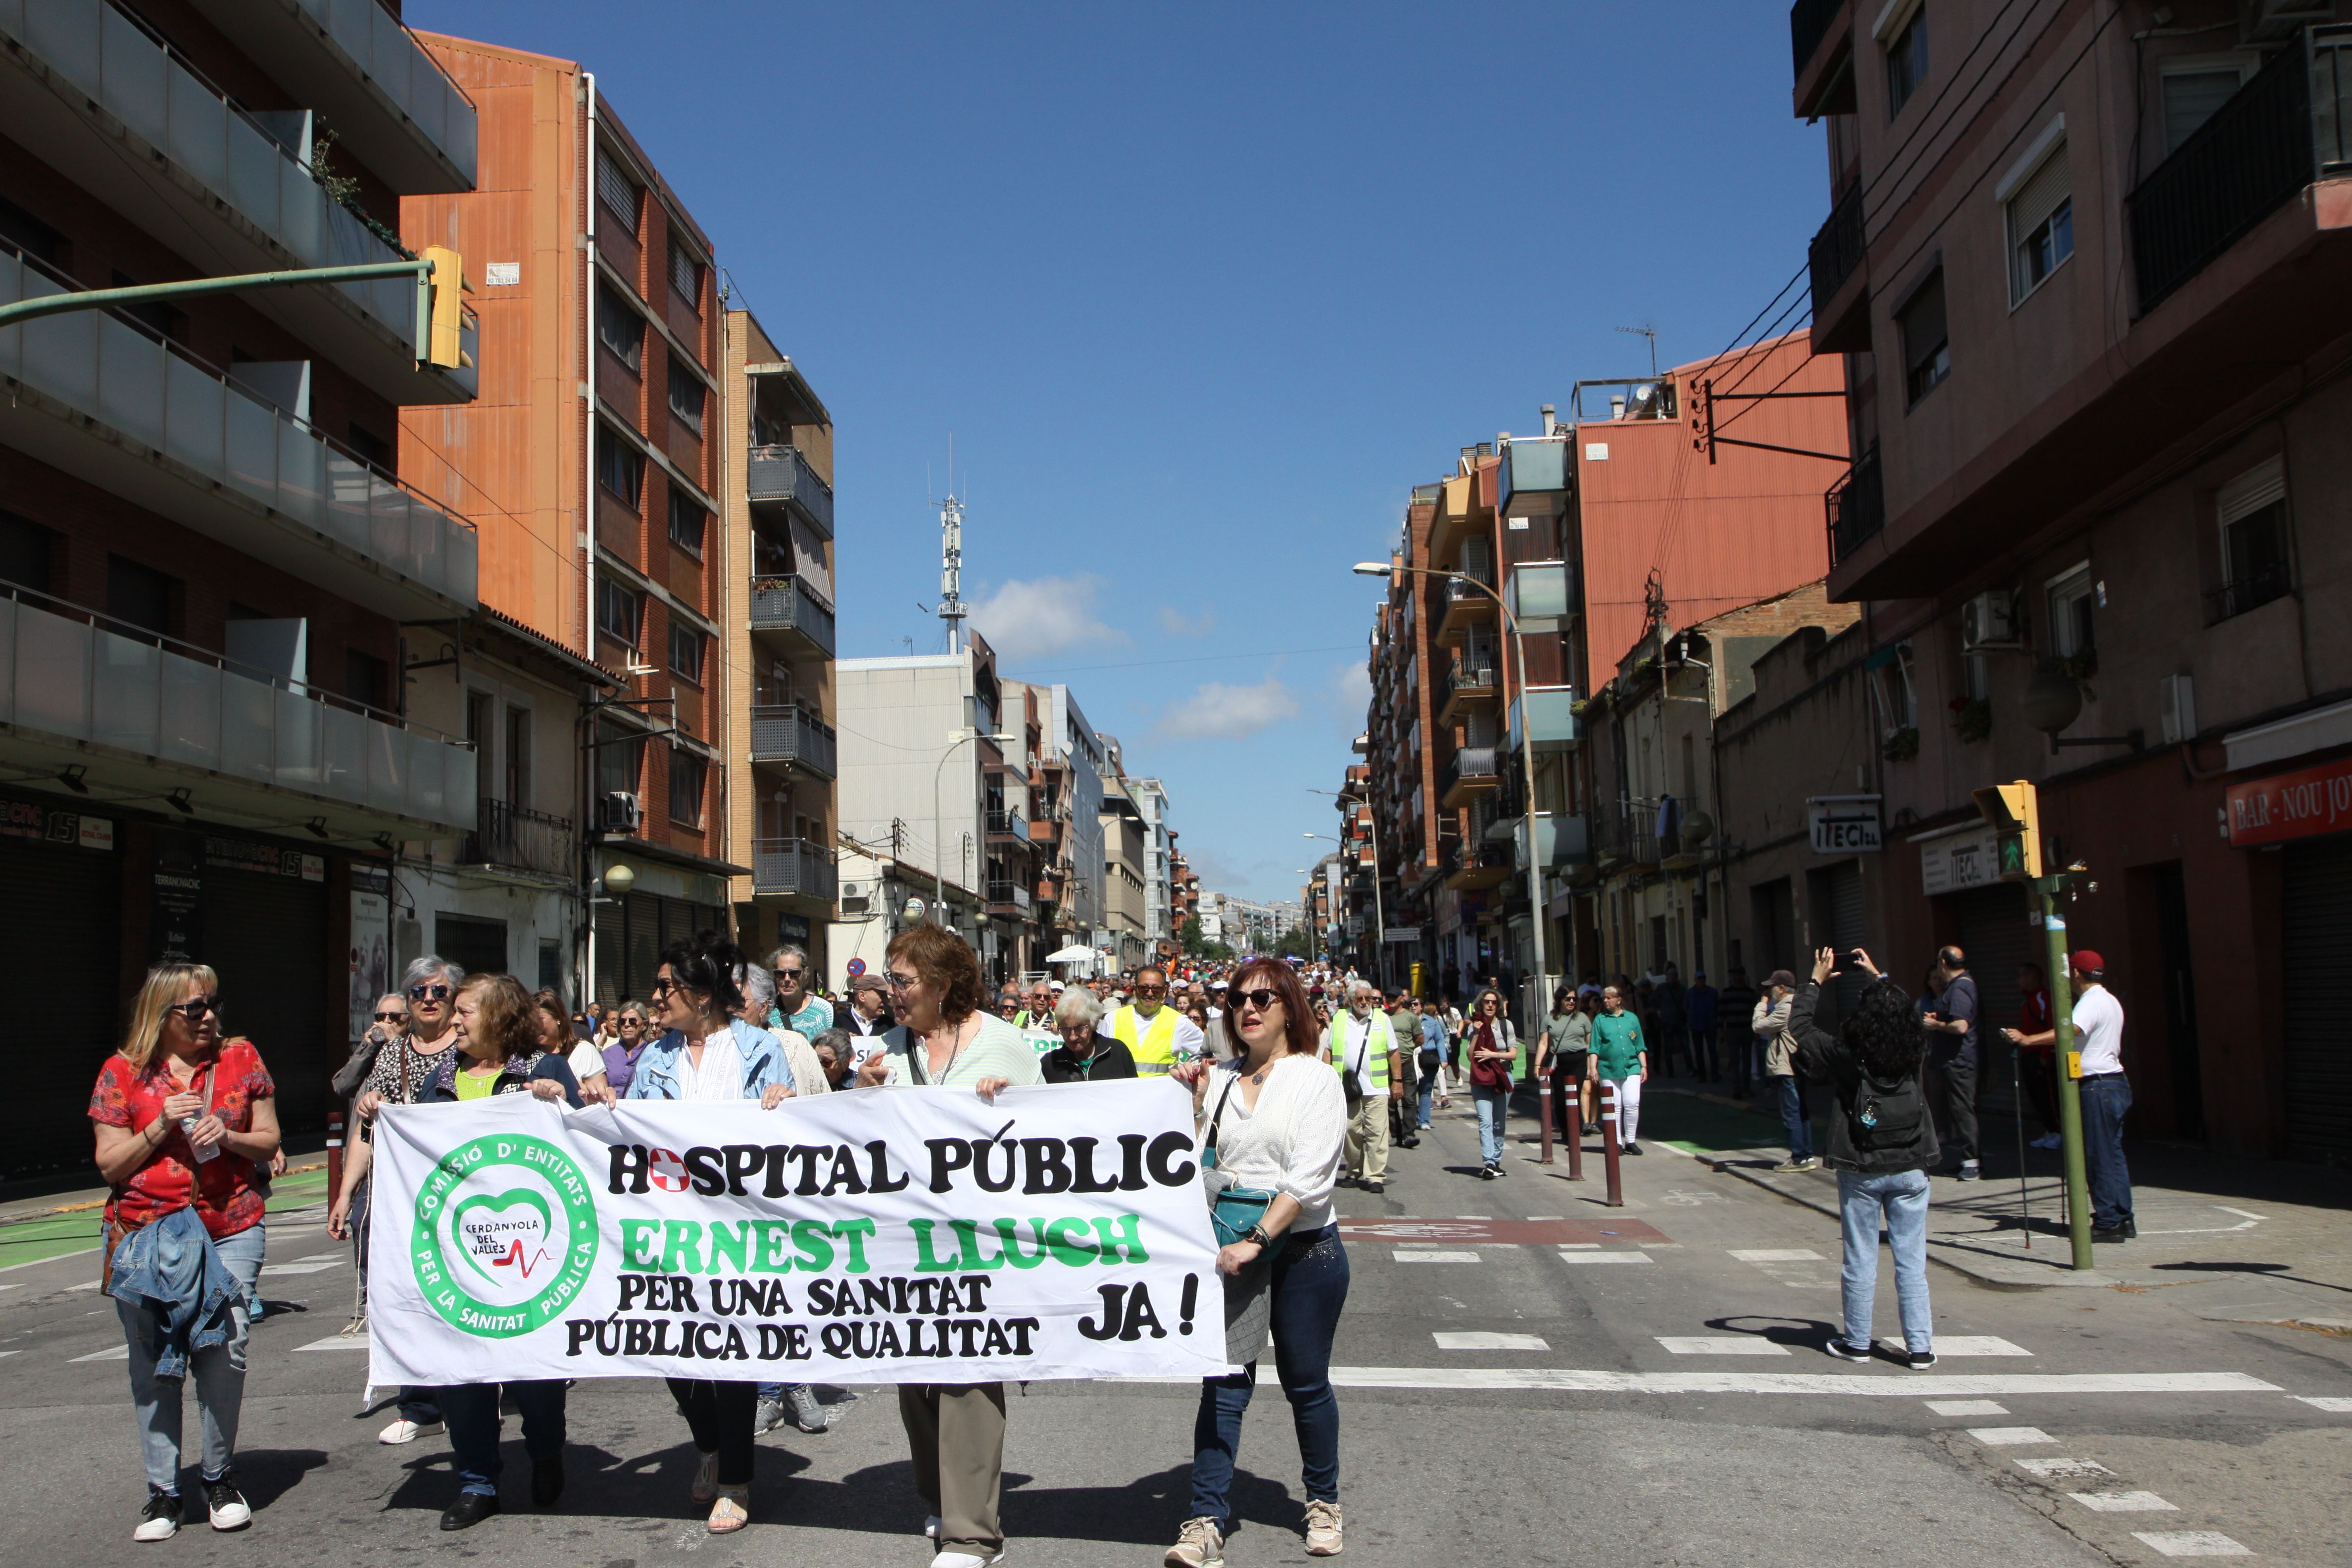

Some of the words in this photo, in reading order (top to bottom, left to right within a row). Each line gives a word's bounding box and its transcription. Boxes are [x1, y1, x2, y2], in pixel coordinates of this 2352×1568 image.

[2235, 793, 2271, 830] BAR
[2281, 781, 2322, 822] NOU
[420, 1145, 483, 1221] COMISSIÓ
[608, 1140, 909, 1198] HOSPITAL
[924, 1120, 1196, 1194] PÚBLIC
[466, 1220, 539, 1233] CERDANYOLA
[477, 1234, 495, 1244] DEL
[619, 1218, 876, 1274] ERNEST
[908, 1215, 1150, 1273] LLUCH
[417, 1251, 440, 1286] PER
[437, 1289, 456, 1311] LA
[459, 1308, 527, 1330] SANITAT
[540, 1242, 592, 1316] PÚBLICA
[617, 1274, 700, 1312] PER
[709, 1278, 793, 1317] UNA
[807, 1275, 991, 1316] SANITAT
[565, 1311, 750, 1361] PÚBLICA
[756, 1323, 812, 1360] DE
[821, 1317, 1040, 1359] QUALITAT
